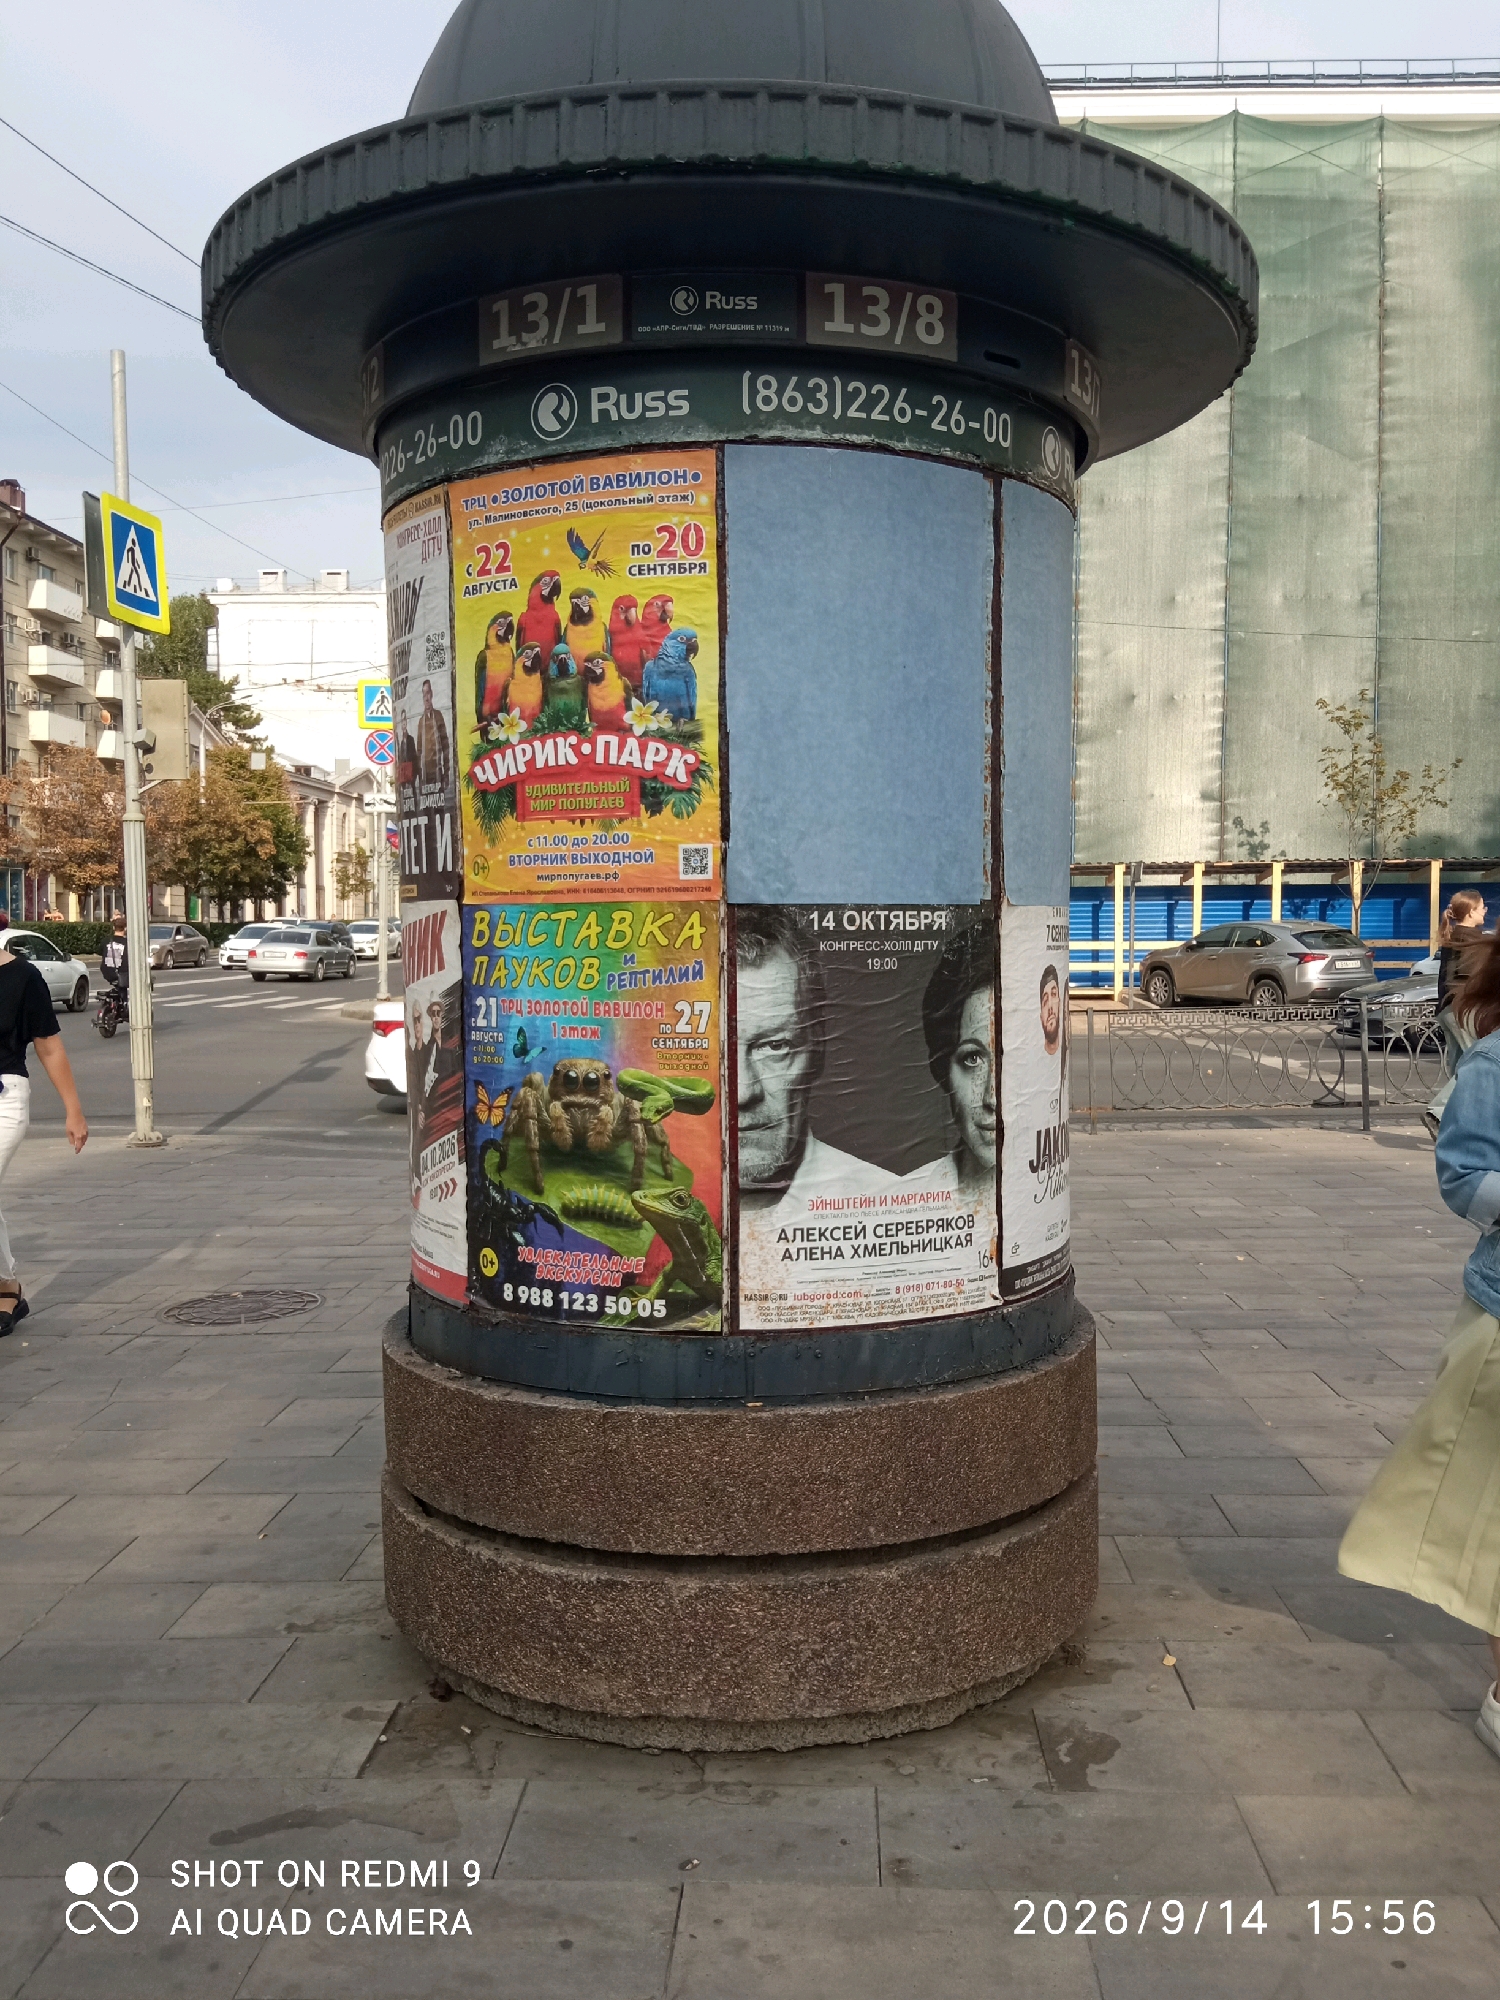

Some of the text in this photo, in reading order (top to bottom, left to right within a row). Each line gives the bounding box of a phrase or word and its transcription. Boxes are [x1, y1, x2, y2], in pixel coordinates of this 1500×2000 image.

[705, 290, 758, 311] Russ
[492, 284, 606, 350] 13/1
[823, 283, 945, 345] 13/8
[591, 386, 690, 423] Russ
[741, 369, 1012, 448] (863)226-26-00
[462, 469, 688, 513] ТРЦ ЗОЛОТОЙ ВАВИЛОН
[467, 491, 696, 531] ул. Малиновского, 25 (цокольный этаж)
[421, 534, 443, 565] ДГТУ
[655, 522, 706, 560] 20
[476, 540, 512, 578] 22
[628, 561, 708, 577] СЕНТЯБРЯ
[462, 578, 518, 598] АВГУСТА
[525, 777, 631, 799] УДИВИТЕЛЬНЫЙ
[530, 796, 625, 812] МИР ПОПУГАЕВ
[435, 813, 453, 873] И
[535, 835, 569, 848] 11.00
[571, 836, 589, 849] до
[592, 832, 630, 846] 20.00
[473, 860, 489, 877] 0+
[508, 848, 655, 868] ВТОРНИК ВЫХОДНОЙ
[536, 871, 620, 883] мирпопугаев.рф
[471, 909, 706, 951] ВЫСТАВКА
[808, 910, 948, 931] 14 ОКТЯБРЯ
[819, 940, 939, 953] КОНГРЕСС-ХОЛЛ ДГТУ
[471, 955, 601, 990] ПАУКОВ
[606, 960, 704, 991] РЕПТИЛИЙ
[866, 957, 898, 970] 19:00
[475, 996, 498, 1028] 21
[500, 996, 665, 1019] ТРЦ ЗОЛОТОЙ ВАВИЛОН
[673, 1001, 712, 1035] 27
[471, 1030, 504, 1043] АВГУСТА
[552, 1023, 601, 1040] 1 этаж
[652, 1038, 709, 1049] СЕНТЯБРЯ
[483, 1056, 504, 1065] 20:00
[808, 1190, 952, 1212] ЭЙНШТЕЙН И МАРГАРИТА
[813, 1212, 849, 1220] СПЕКТАКЛЬ
[776, 1213, 975, 1244] АЛЕКСЕЙ СЕРЕБРЯКОВ
[780, 1232, 974, 1262] АЛЕНА ХМЕЛЬНИЦКАЯ
[481, 1253, 496, 1269] 0+
[517, 1246, 646, 1274] УВЛЕКАТЕЛЬНЫЕ
[535, 1266, 623, 1288] ЭКСКУРСИИ
[895, 1286, 901, 1295] 8
[902, 1283, 924, 1295] (918)
[925, 1278, 965, 1291] 071-80-50
[503, 1283, 667, 1318] 8 988 123 50 05
